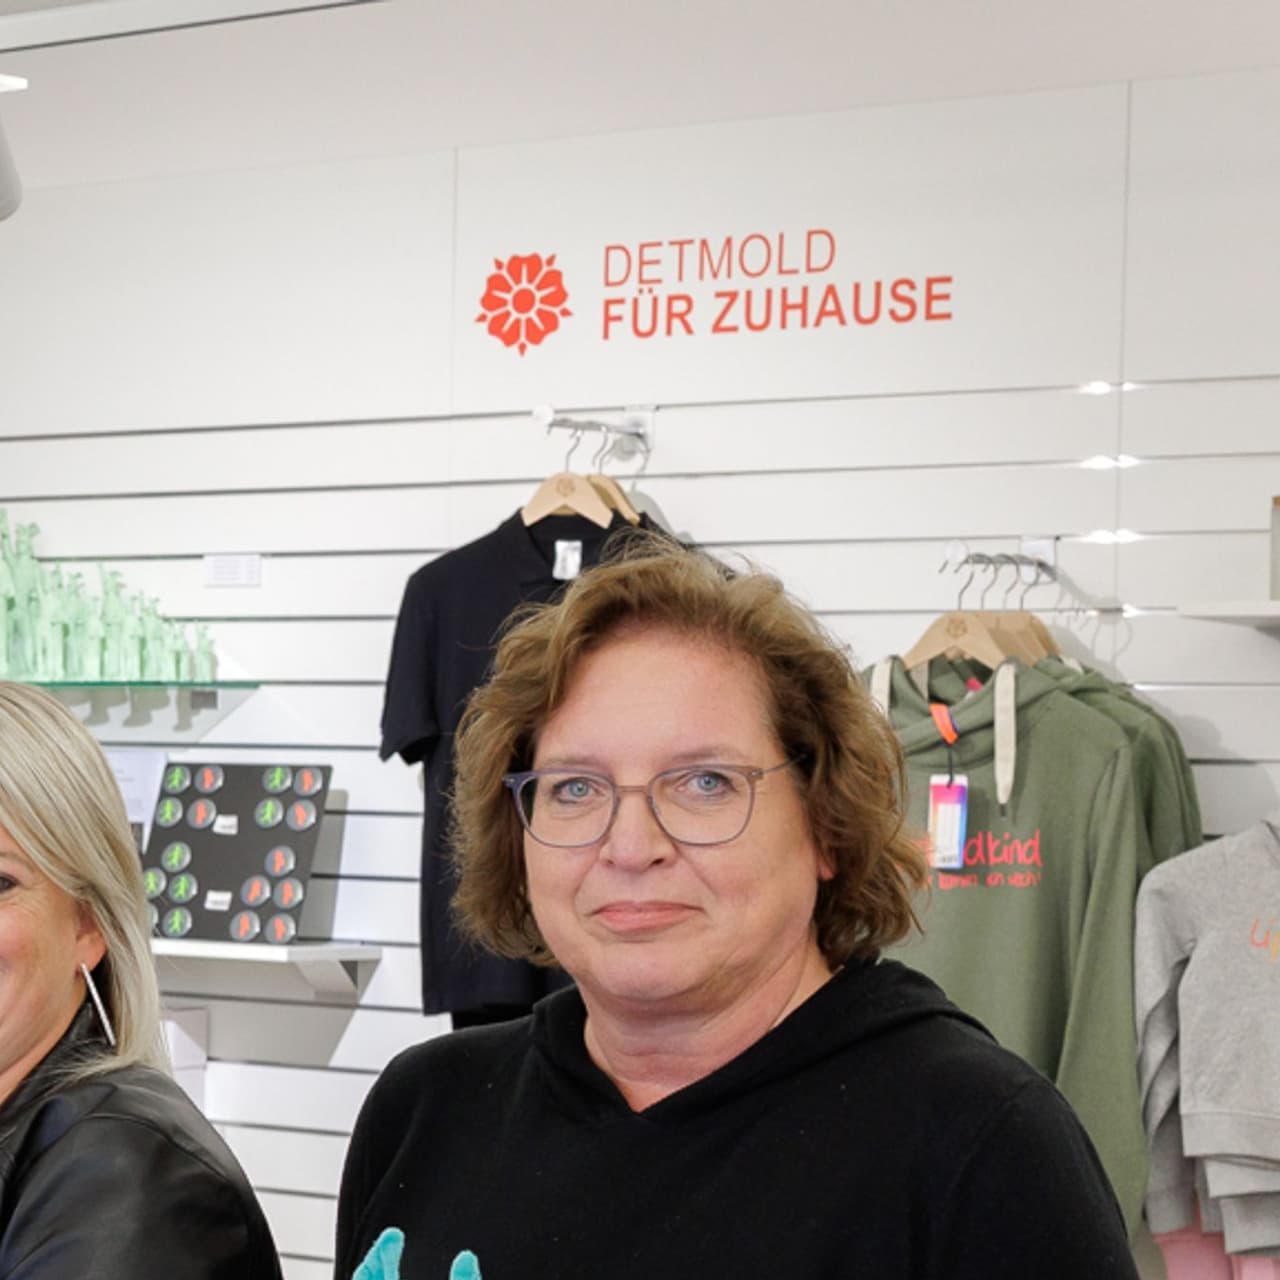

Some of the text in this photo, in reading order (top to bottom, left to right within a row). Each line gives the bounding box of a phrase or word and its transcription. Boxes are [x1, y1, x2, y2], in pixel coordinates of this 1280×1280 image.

[603, 229, 836, 287] DETMOLD
[602, 276, 953, 341] FÜR ZUHAUSE
